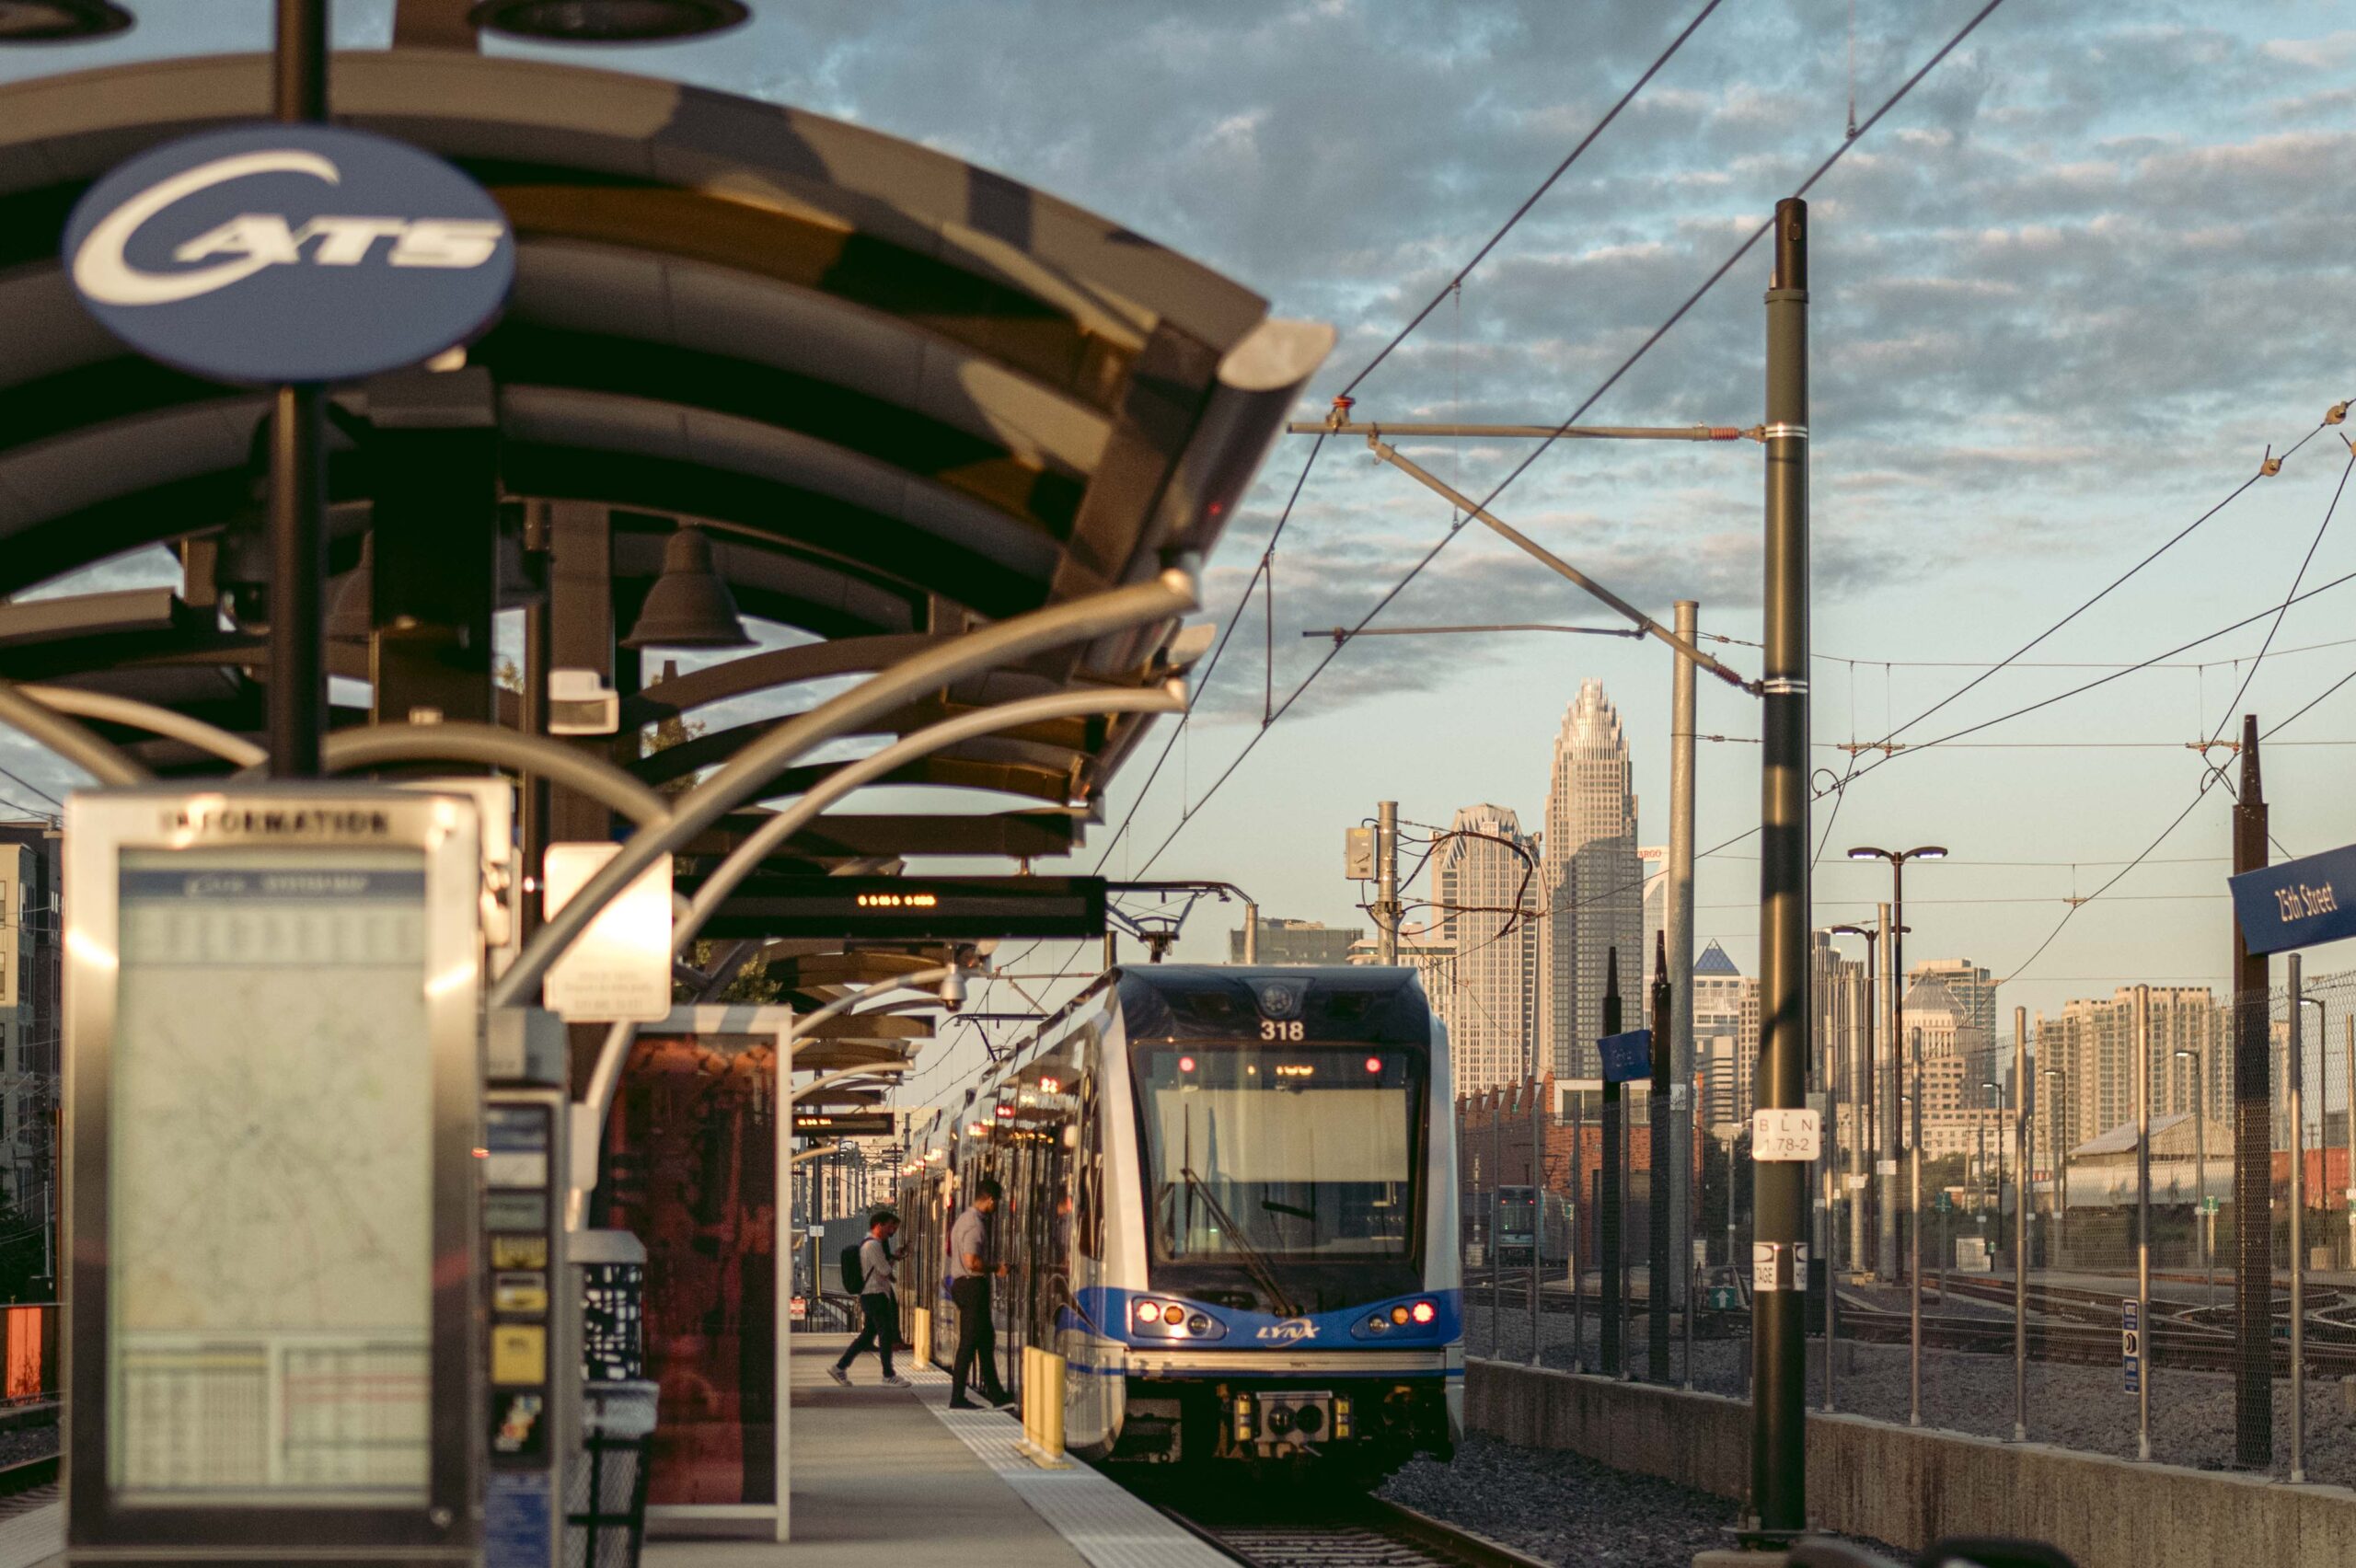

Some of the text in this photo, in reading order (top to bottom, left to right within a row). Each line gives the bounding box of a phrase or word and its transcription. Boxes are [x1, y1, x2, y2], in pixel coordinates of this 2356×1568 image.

[1637, 848, 1662, 859] ARGO
[2274, 882, 2339, 922] 25th Street
[1260, 1020, 1304, 1042] 318
[1763, 1137, 1810, 1151] 1.78-2
[1754, 1267, 1773, 1284] TAGE
[1256, 1320, 1321, 1343] LYNX
